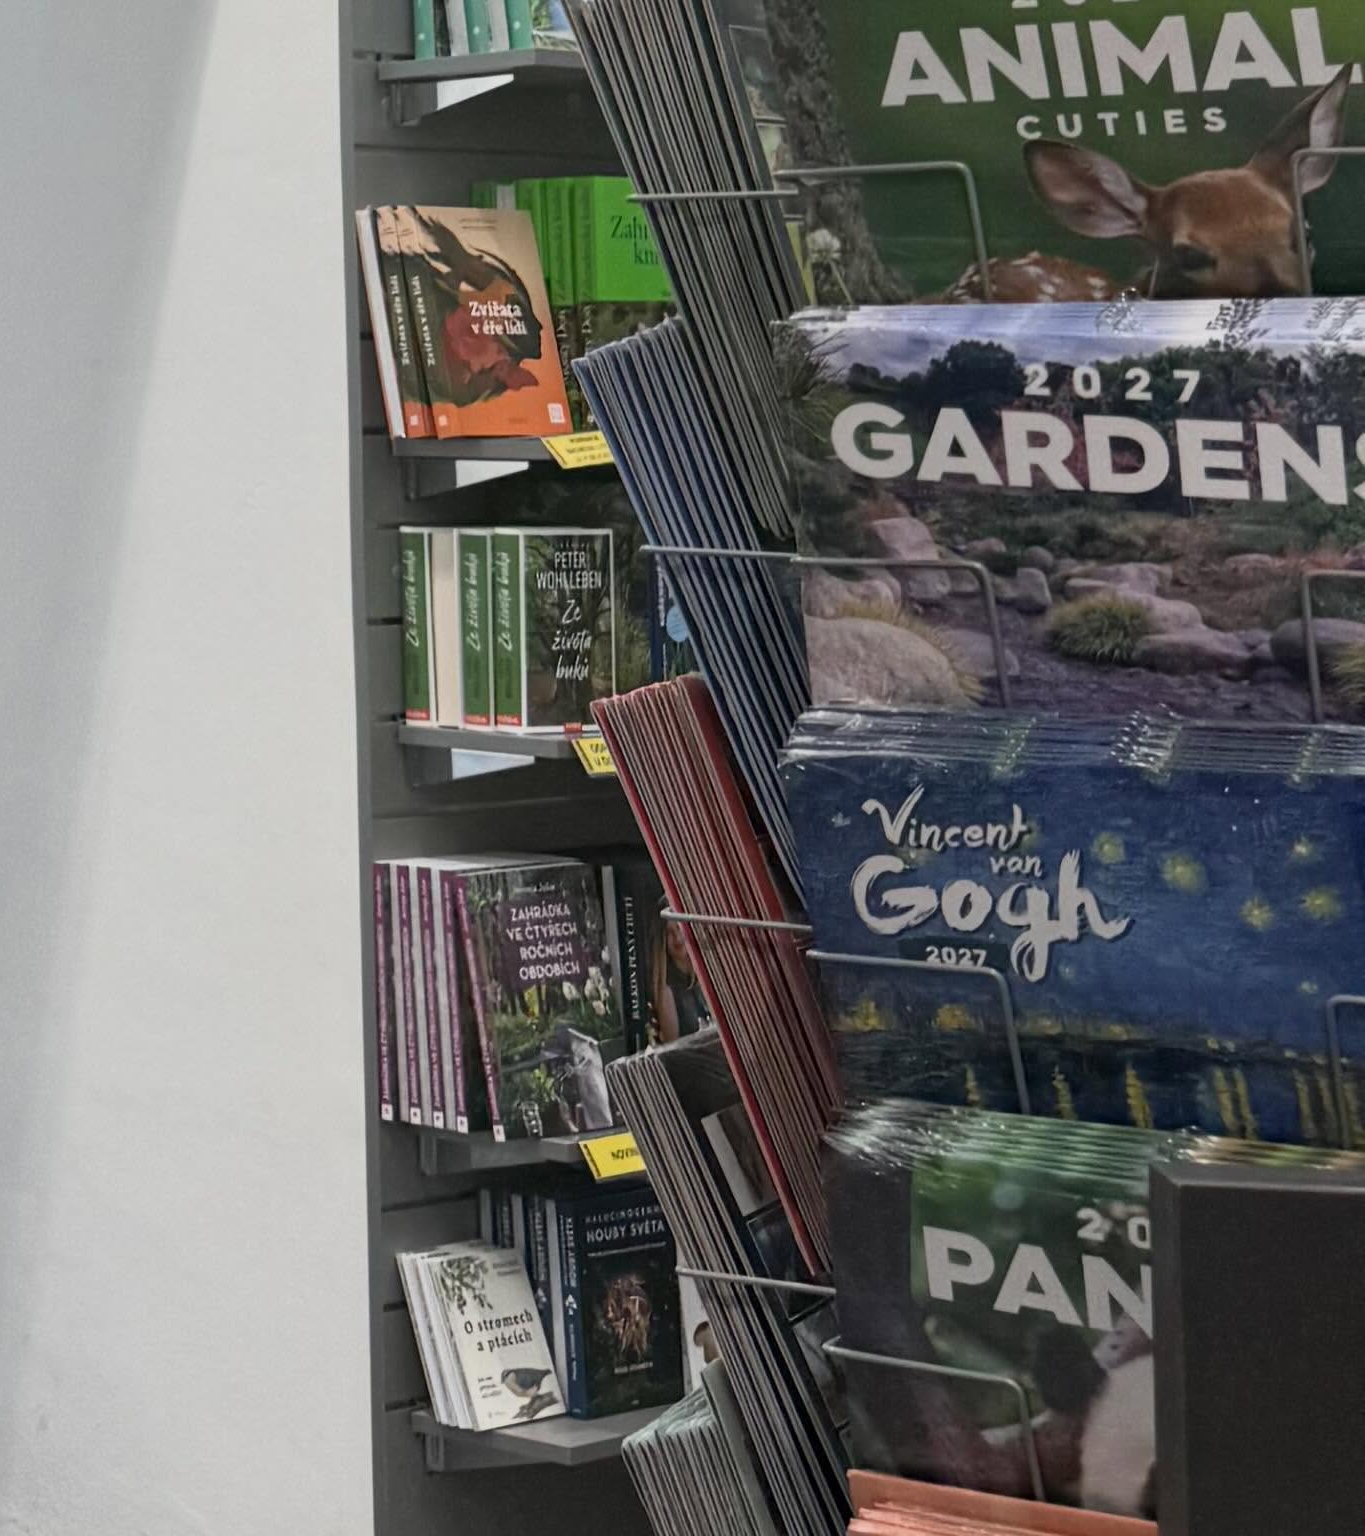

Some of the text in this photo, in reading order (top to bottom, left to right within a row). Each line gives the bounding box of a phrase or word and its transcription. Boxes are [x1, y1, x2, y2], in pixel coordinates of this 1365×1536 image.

[880, 7, 1365, 107] ANIMAL
[1016, 106, 1227, 140] CUTIES
[1023, 363, 1201, 403] 2027
[830, 402, 1365, 507] GARDEN
[554, 551, 587, 569] PETER
[562, 599, 582, 625] Ze
[861, 783, 1031, 852] Vincent
[989, 855, 1043, 877] van
[510, 900, 571, 922] ZAHRÁDKA
[851, 848, 1132, 983] Gogh
[506, 927, 523, 941] VE
[519, 957, 580, 980] OBDOBÍCH
[925, 945, 987, 967] 2027
[586, 1225, 626, 1243] HOUBY
[1076, 1207, 1153, 1251] 20
[921, 1225, 1154, 1341] PAN
[464, 1309, 534, 1334] O stromech
[477, 1328, 533, 1353] a ptácích
